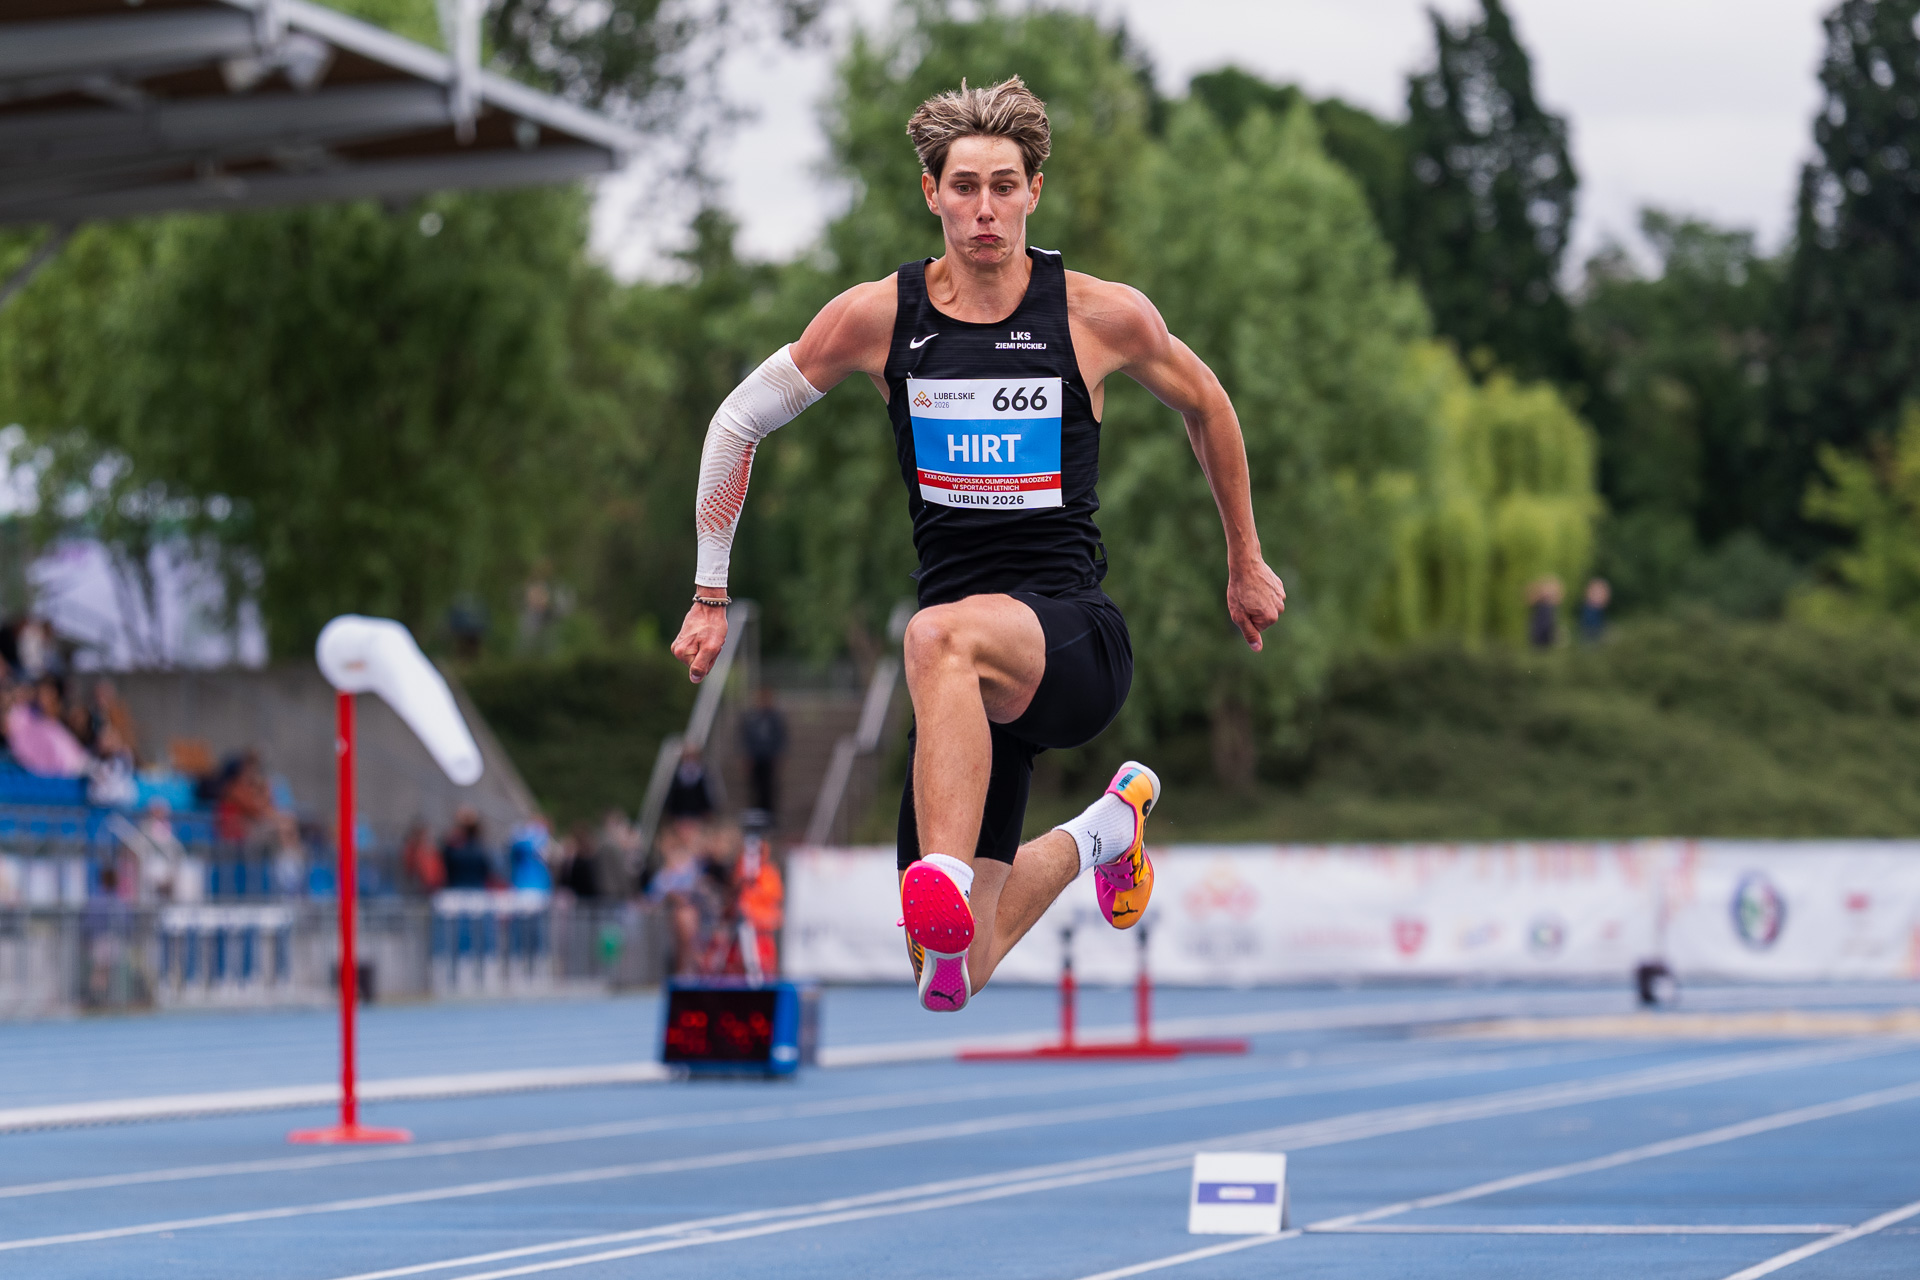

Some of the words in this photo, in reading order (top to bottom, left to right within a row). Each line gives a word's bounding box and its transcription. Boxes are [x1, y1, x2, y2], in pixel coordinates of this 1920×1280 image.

[1010, 331, 1032, 341] LKS
[994, 342, 1016, 350] ZIEMI
[1016, 342, 1047, 350] PUCKIEJ
[933, 392, 976, 400] LUBELSKIE
[992, 386, 1048, 412] 666
[934, 401, 950, 409] 2026
[947, 434, 1022, 463] HIRT
[937, 475, 984, 485] OGÓLNOPOLSKA
[985, 477, 1020, 485] OLIMPIADA
[948, 493, 990, 505] LUBLIN
[992, 495, 1025, 505] 2026
